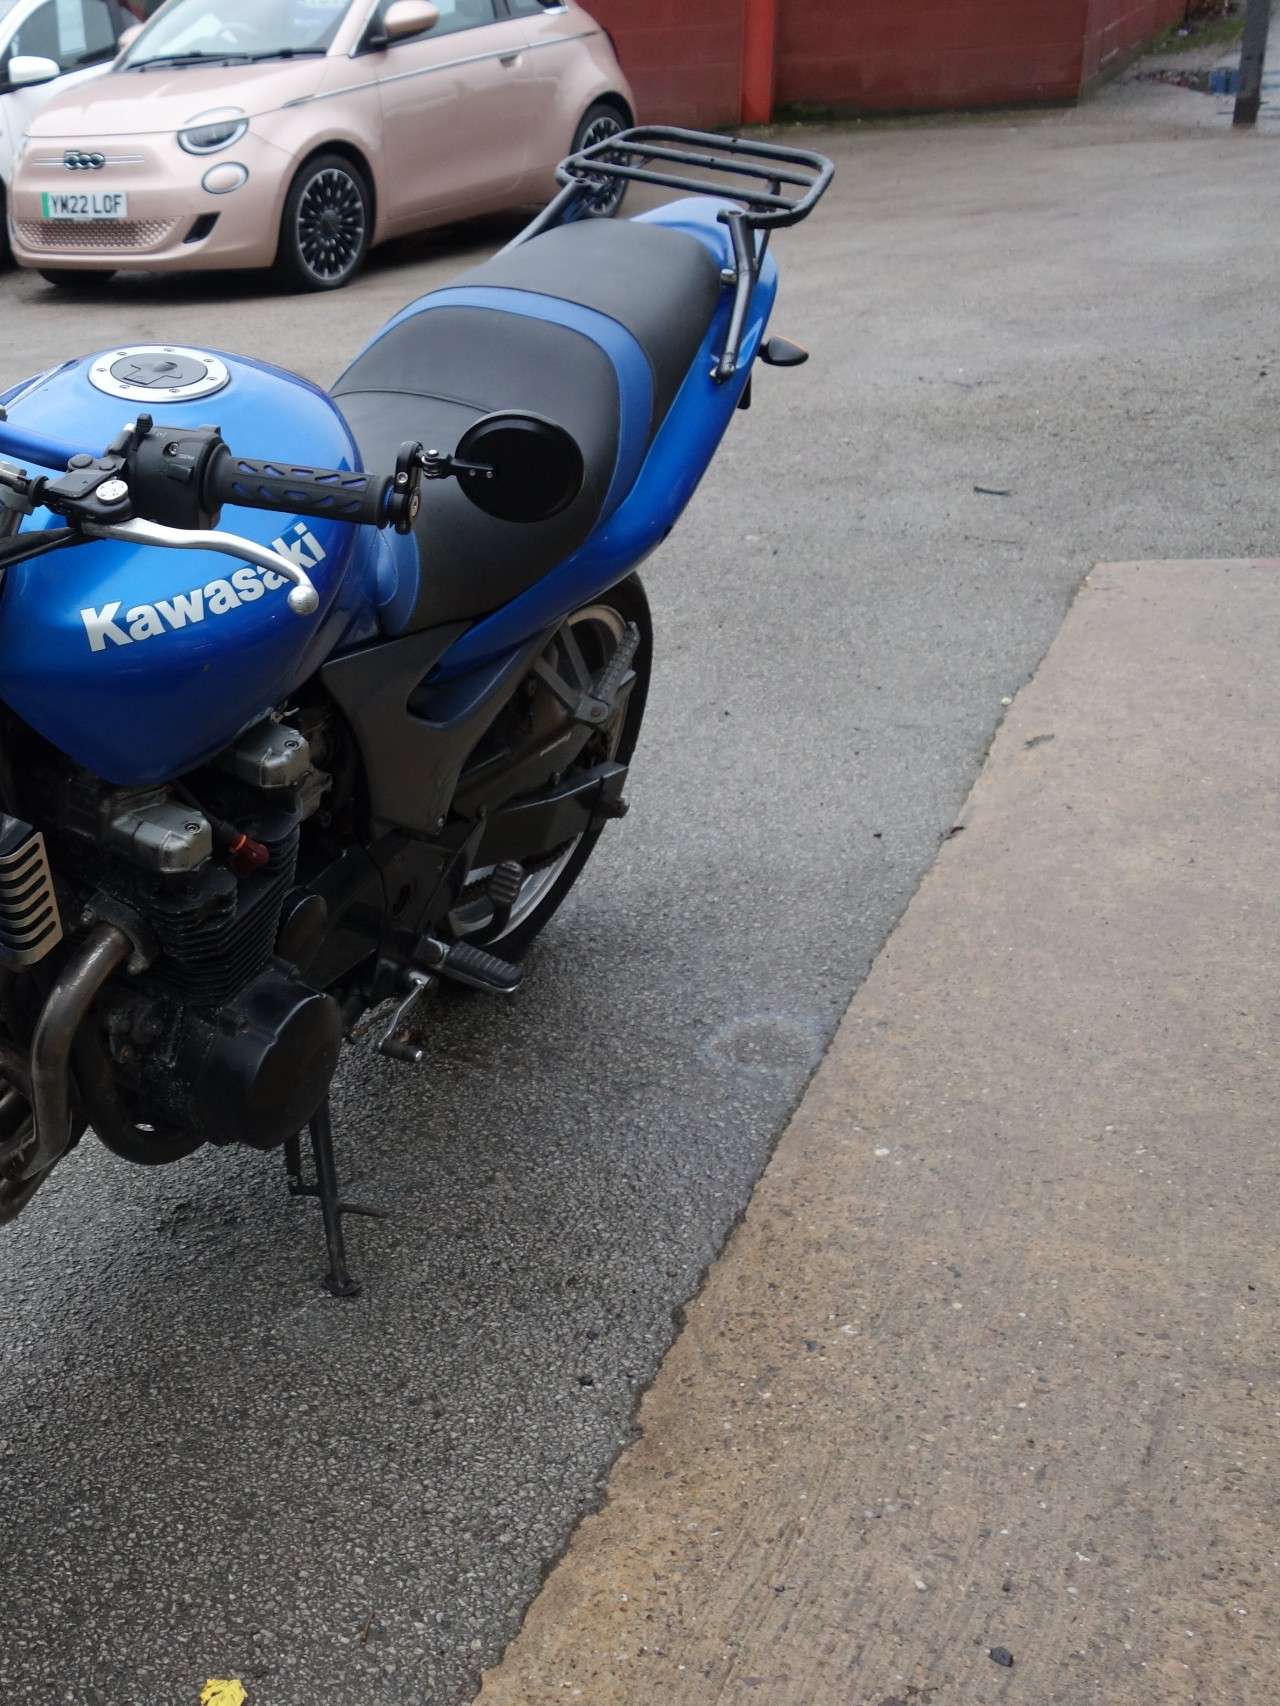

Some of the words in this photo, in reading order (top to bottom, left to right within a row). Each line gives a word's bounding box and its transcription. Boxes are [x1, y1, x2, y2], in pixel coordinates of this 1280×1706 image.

[51, 195, 89, 214] YM22
[92, 194, 122, 214] LOF
[80, 522, 326, 652] Kawasaki
